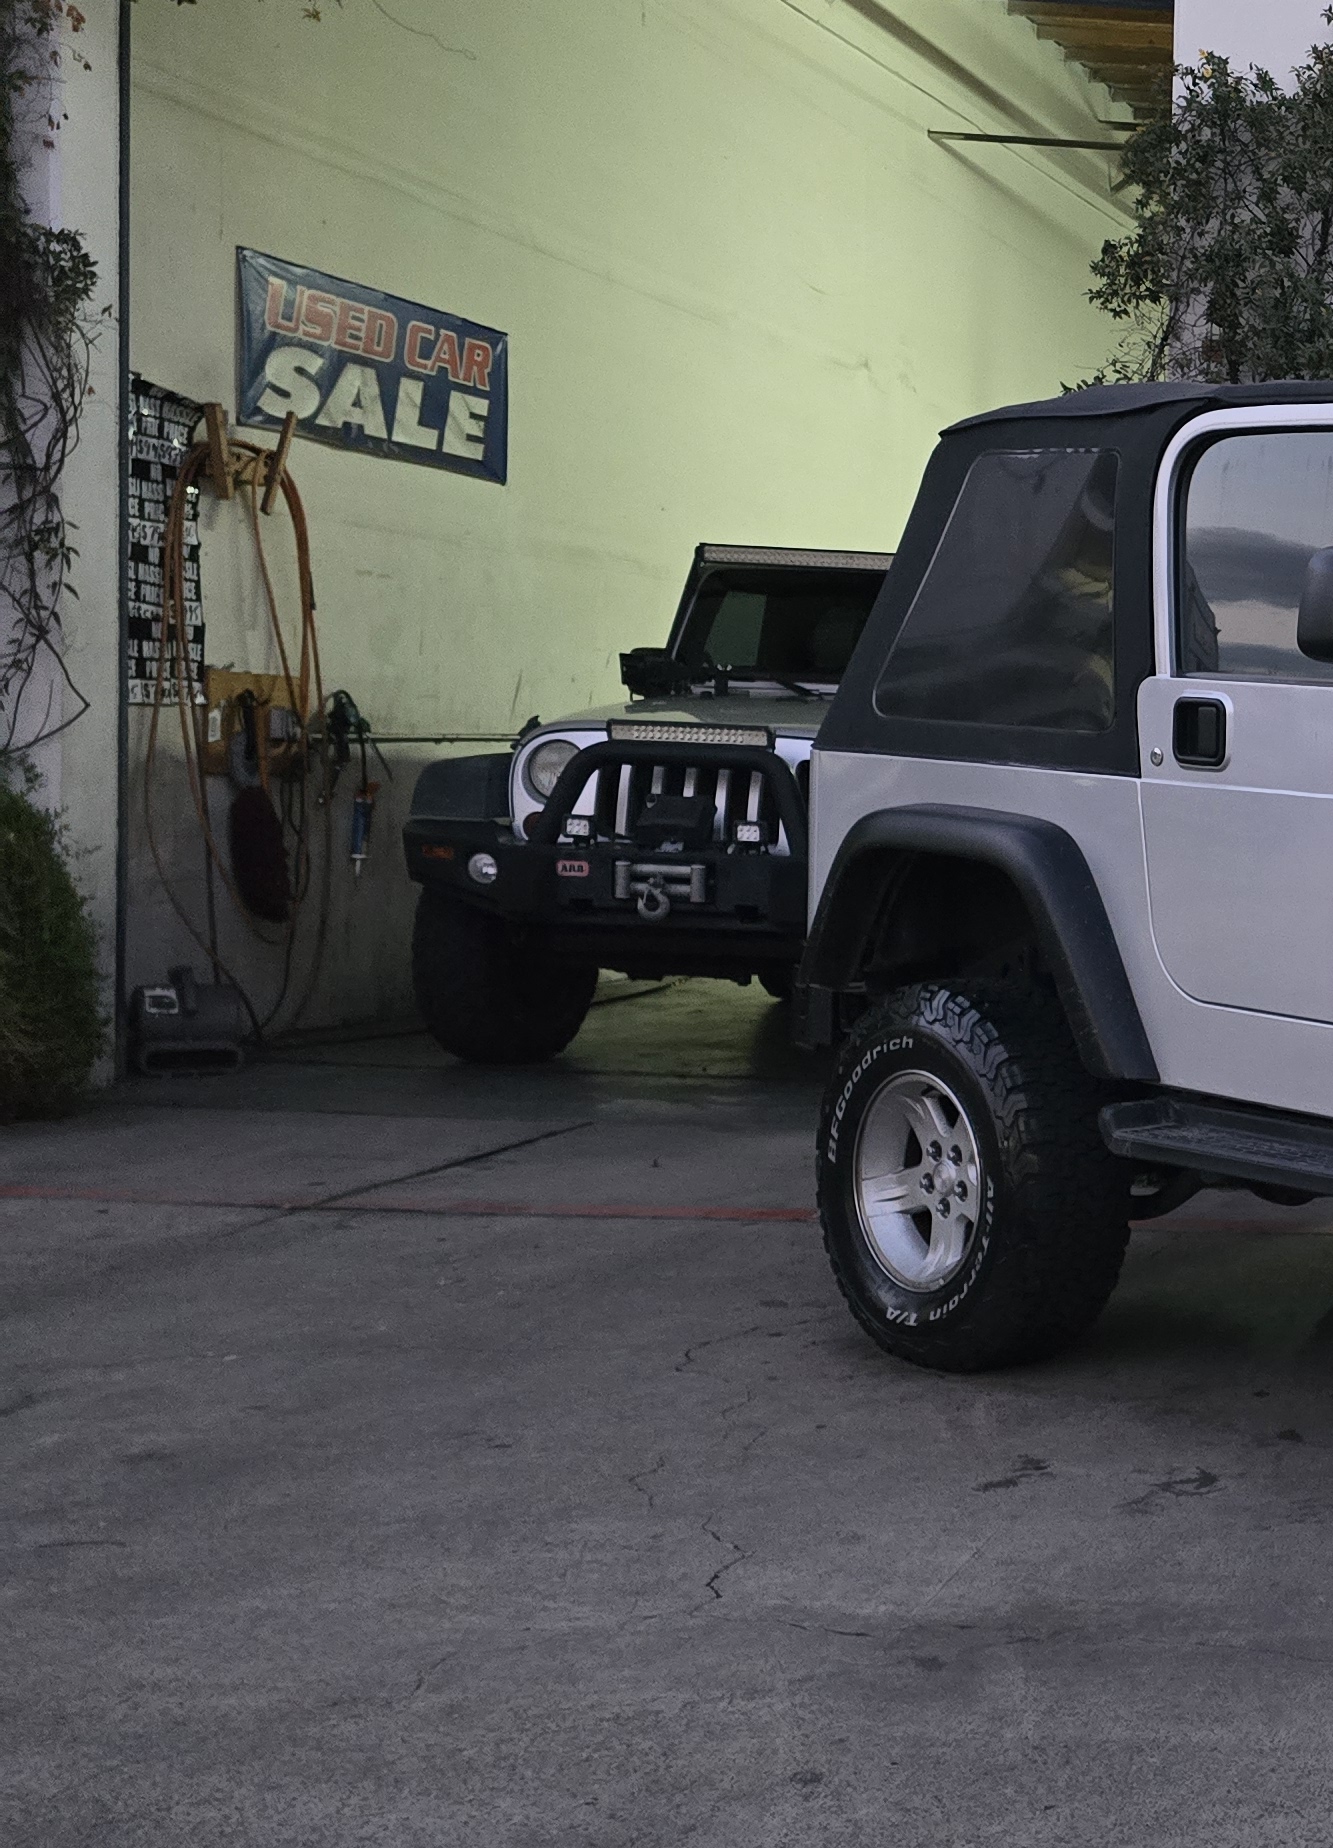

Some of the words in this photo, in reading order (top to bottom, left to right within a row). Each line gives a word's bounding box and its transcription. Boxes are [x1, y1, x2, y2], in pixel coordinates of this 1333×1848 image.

[264, 275, 398, 362] USED
[404, 320, 493, 391] CAR
[256, 345, 490, 461] SALE
[827, 1035, 914, 1164] BFGoodrich
